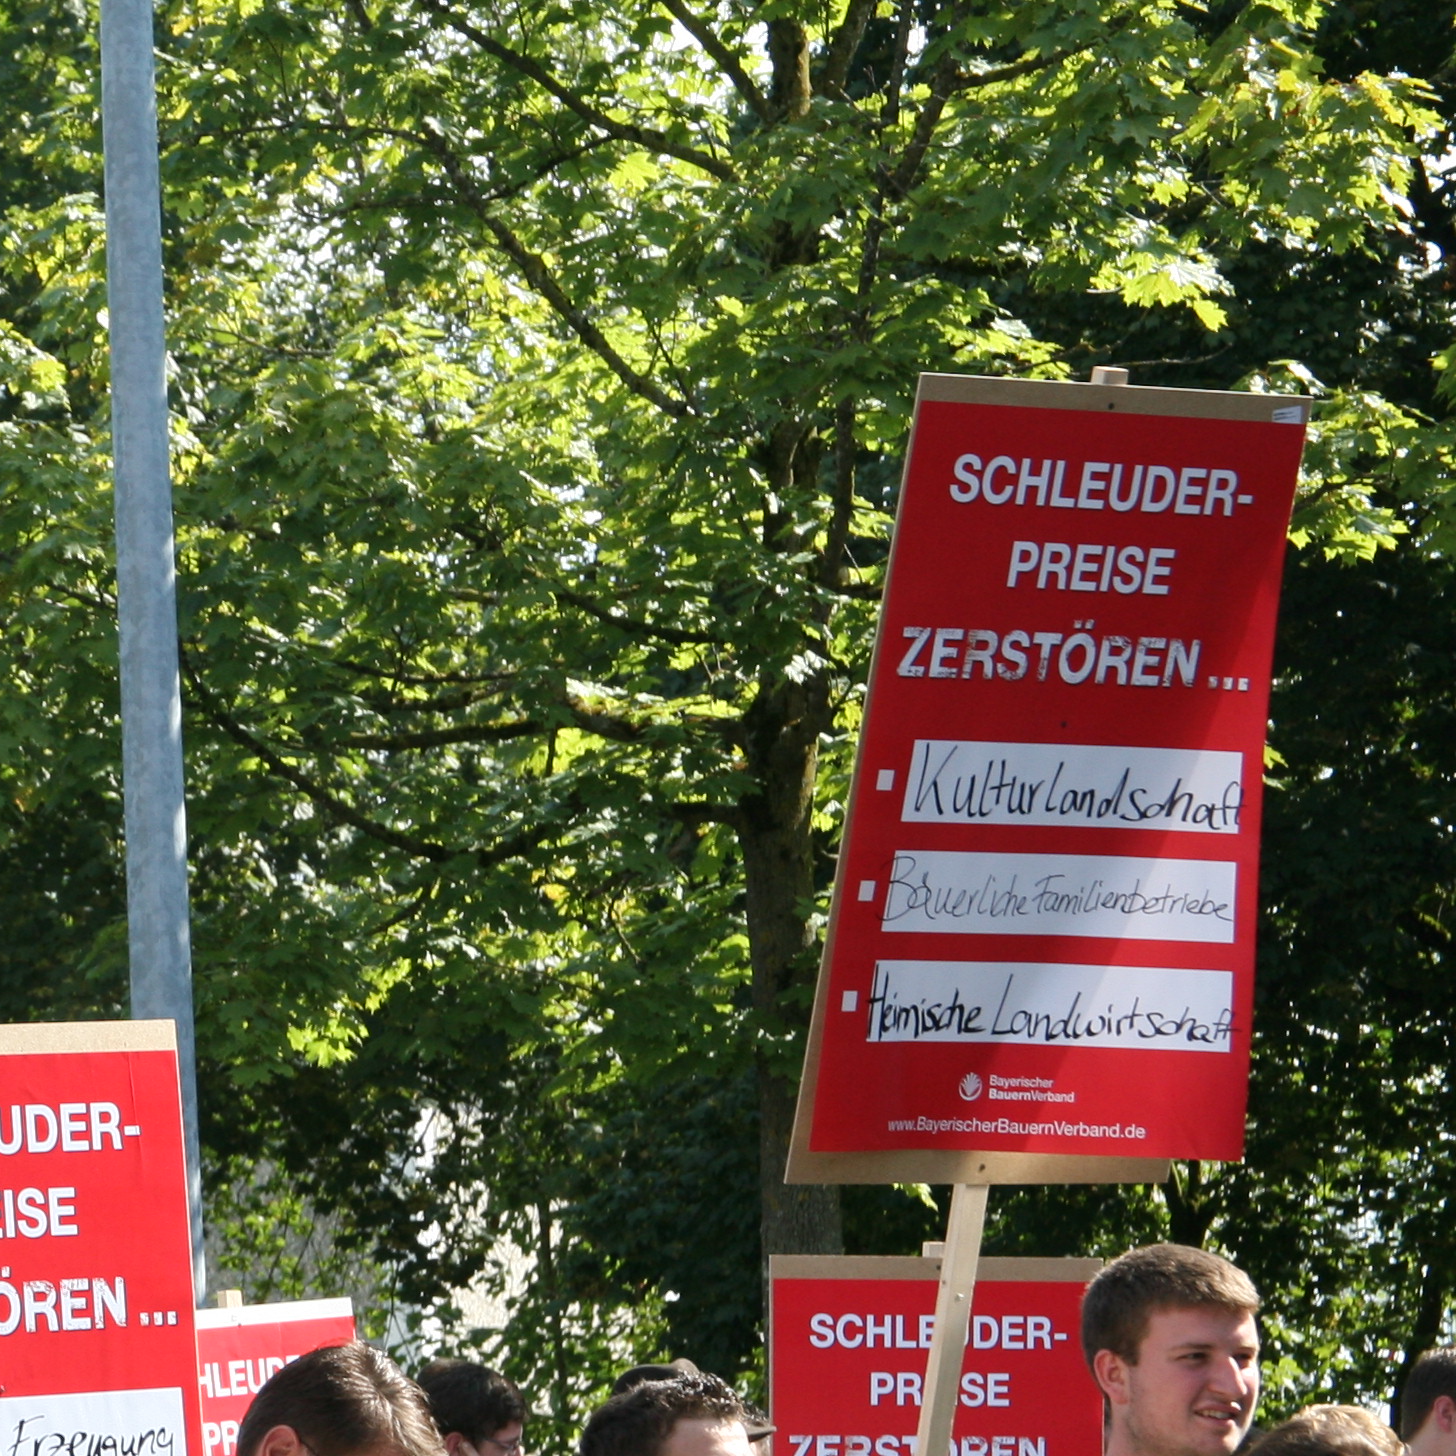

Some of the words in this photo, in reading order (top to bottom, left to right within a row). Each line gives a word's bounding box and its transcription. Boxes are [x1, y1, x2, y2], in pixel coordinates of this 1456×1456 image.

[949, 453, 1253, 517] SCHLEUDER-
[1006, 541, 1175, 596] PREISE
[913, 743, 1246, 830] Kulturlandschaft
[1035, 874, 1233, 923] Familienbetriebe
[868, 960, 985, 1041] Heimische
[992, 973, 1243, 1043] Landwirtschaft
[989, 1074, 1053, 1089] Bayerischer
[989, 1088, 1074, 1103] BauernVerband
[887, 1117, 1146, 1140] www.BayerischerBauernVerband.de
[809, 1313, 1067, 1350] SCHLEDER-
[870, 1372, 1010, 1407] PRSE
